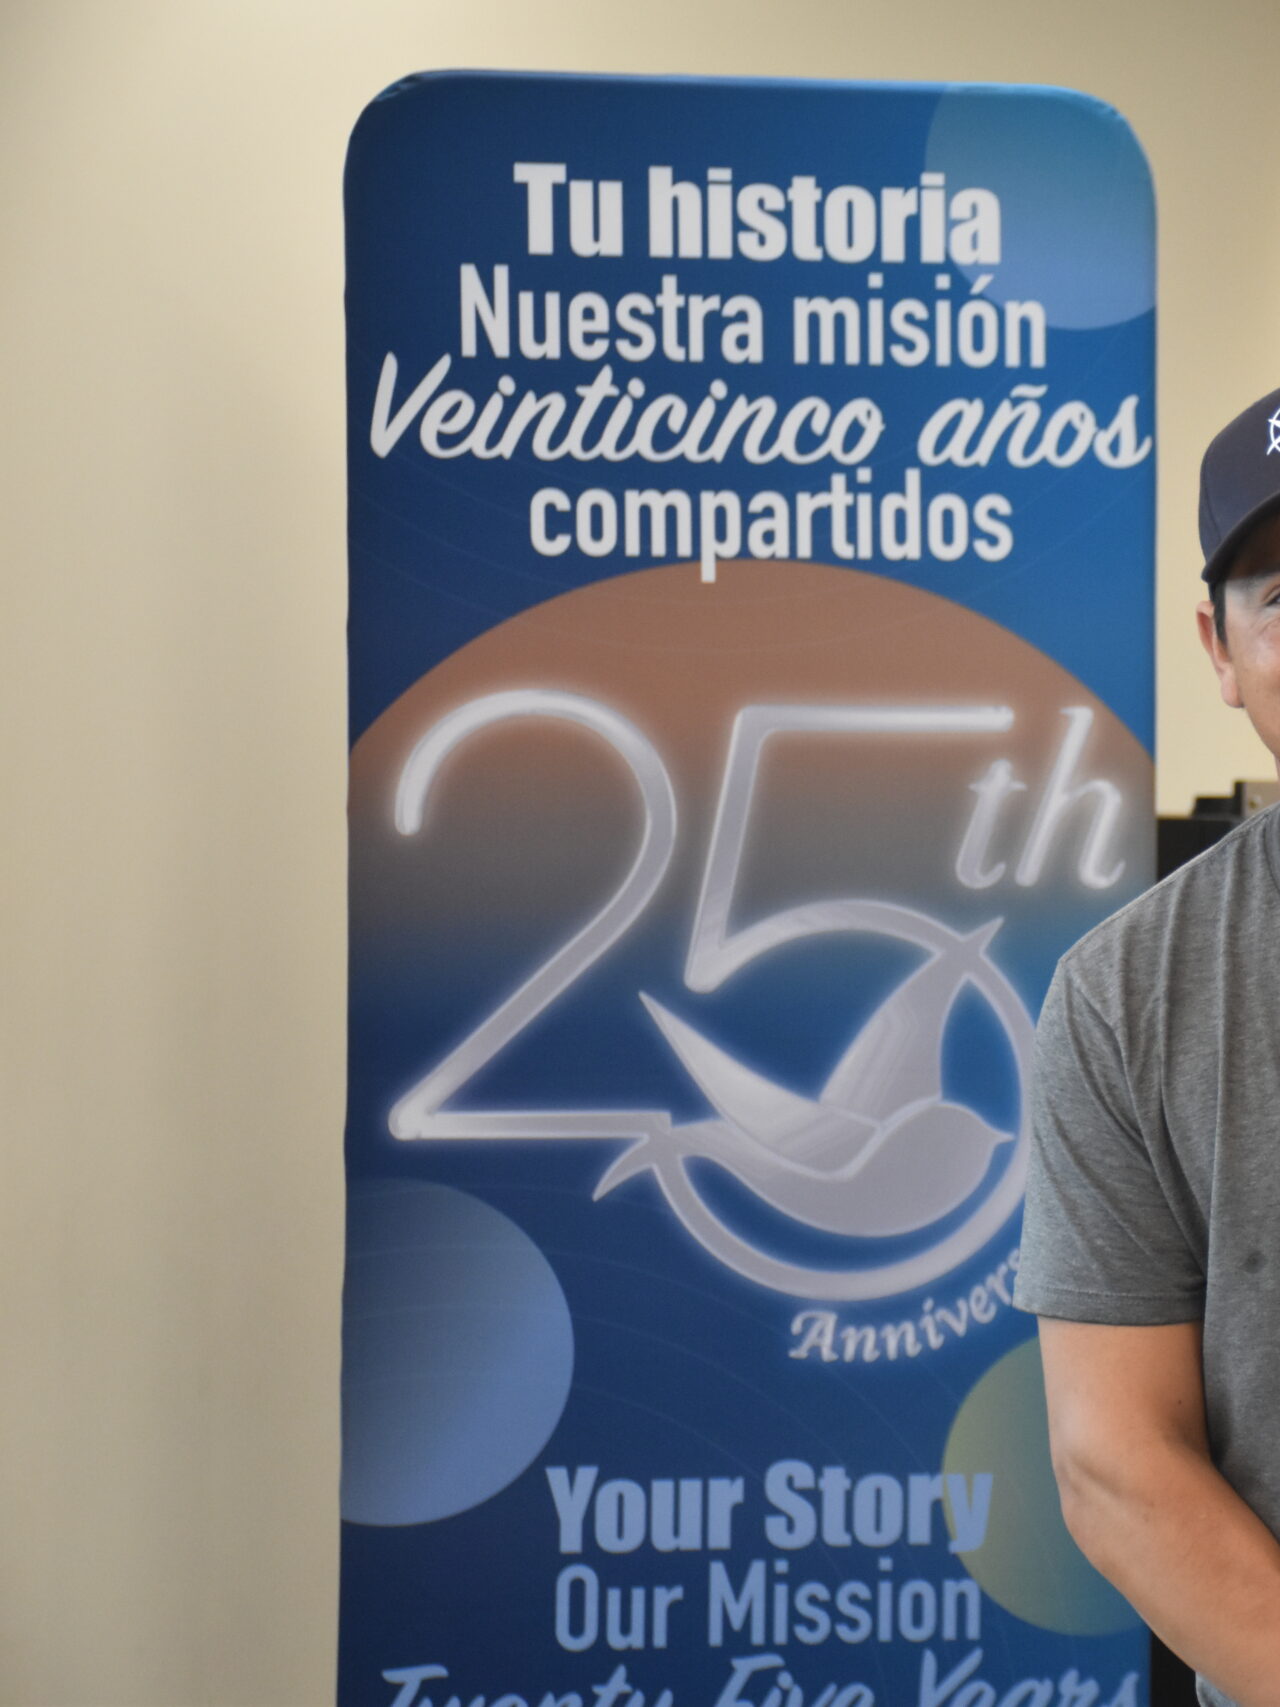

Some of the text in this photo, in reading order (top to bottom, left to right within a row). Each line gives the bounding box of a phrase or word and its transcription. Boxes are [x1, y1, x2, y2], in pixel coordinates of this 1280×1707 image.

[513, 162, 1001, 264] Tu historia
[459, 264, 1047, 368] Nuestra misión
[369, 352, 1153, 468] Veinticinco años
[529, 467, 1014, 583] compartidos
[545, 1459, 994, 1554] Your Story
[554, 1557, 982, 1652] Our Mission
